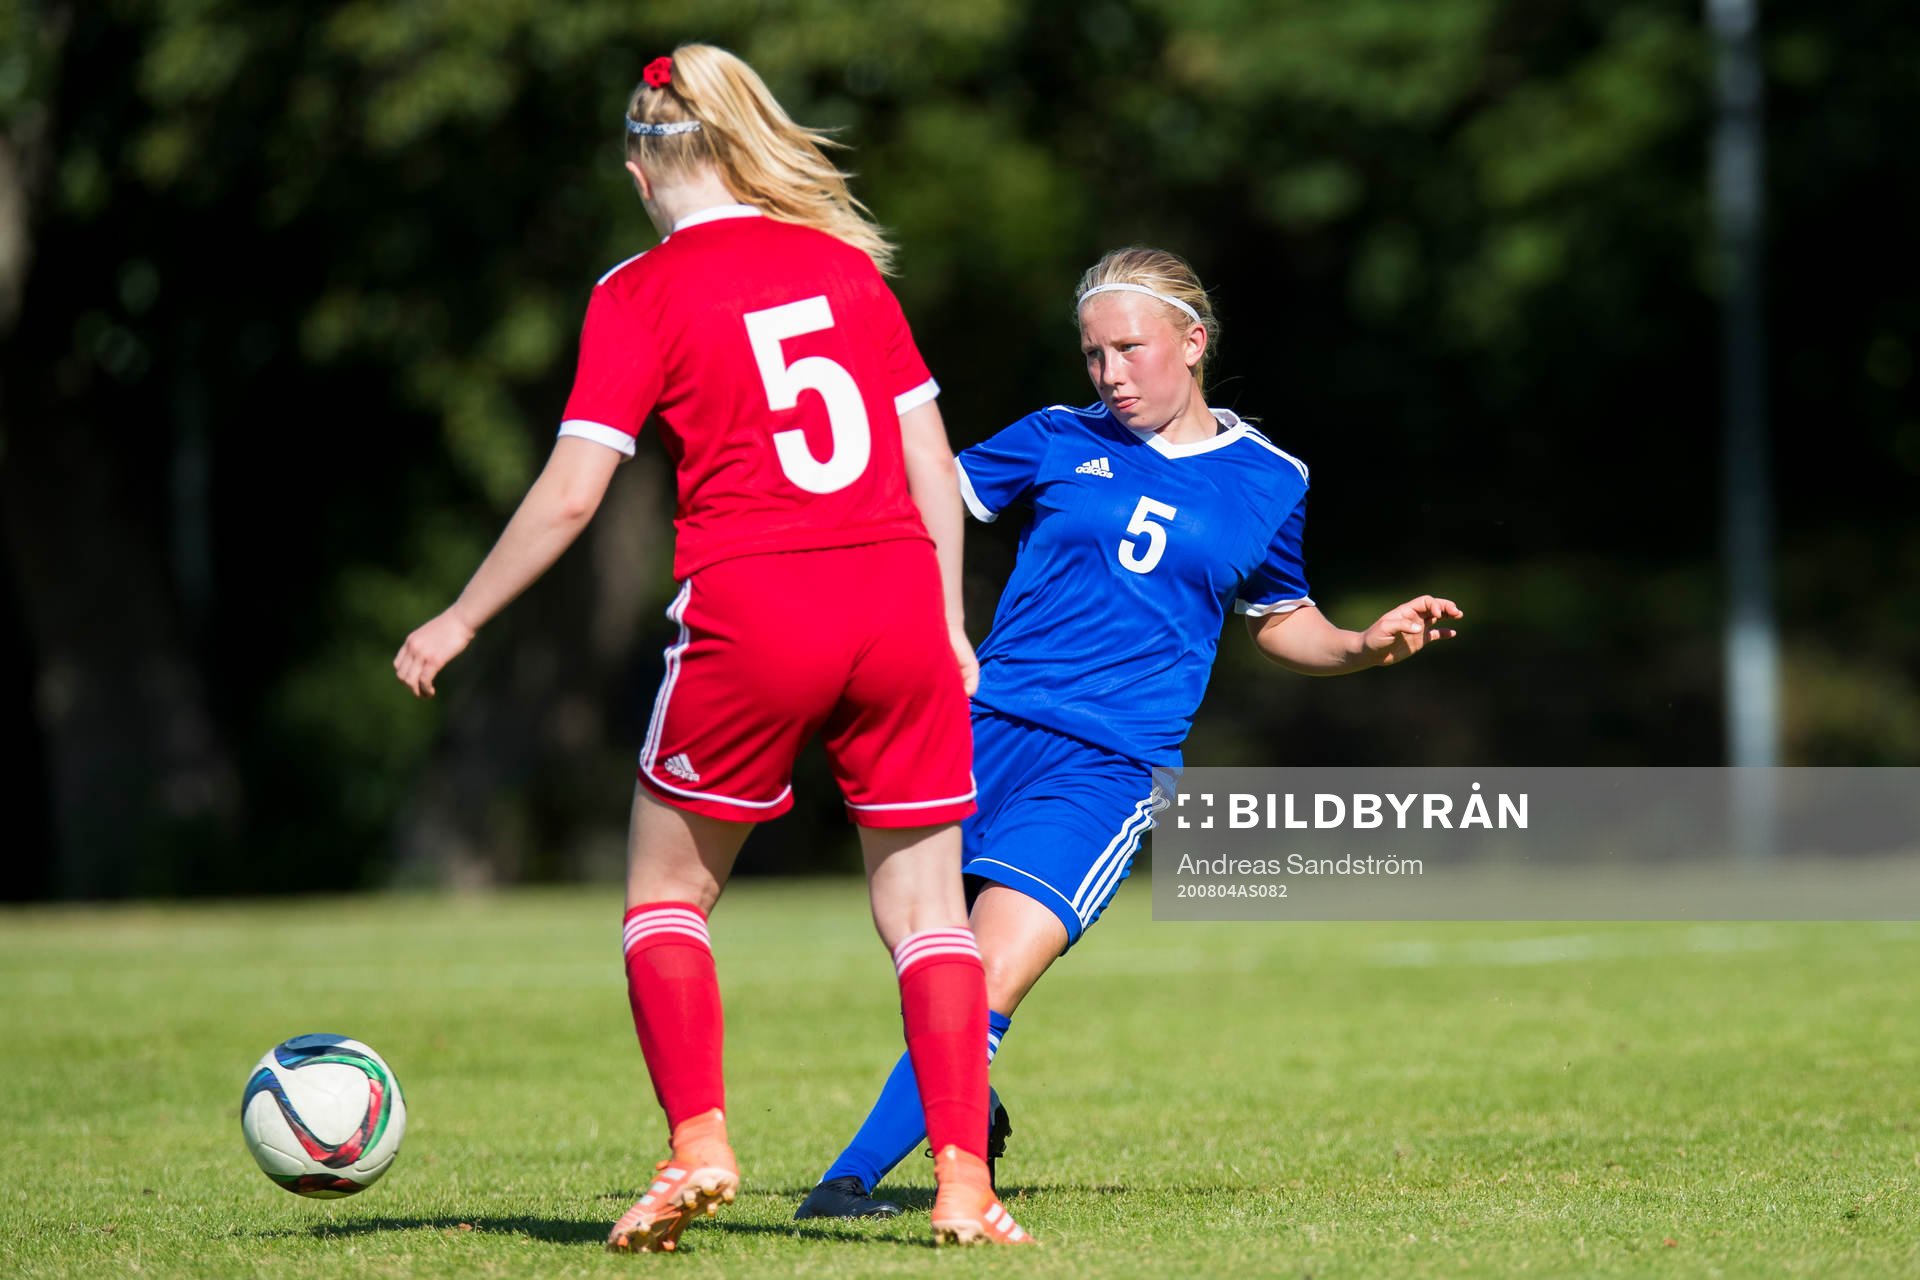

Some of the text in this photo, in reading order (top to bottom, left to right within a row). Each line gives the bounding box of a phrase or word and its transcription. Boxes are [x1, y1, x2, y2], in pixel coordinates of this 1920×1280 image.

[744, 296, 871, 494] 5
[1075, 465, 1114, 479] adidas
[1118, 495, 1177, 574] 5
